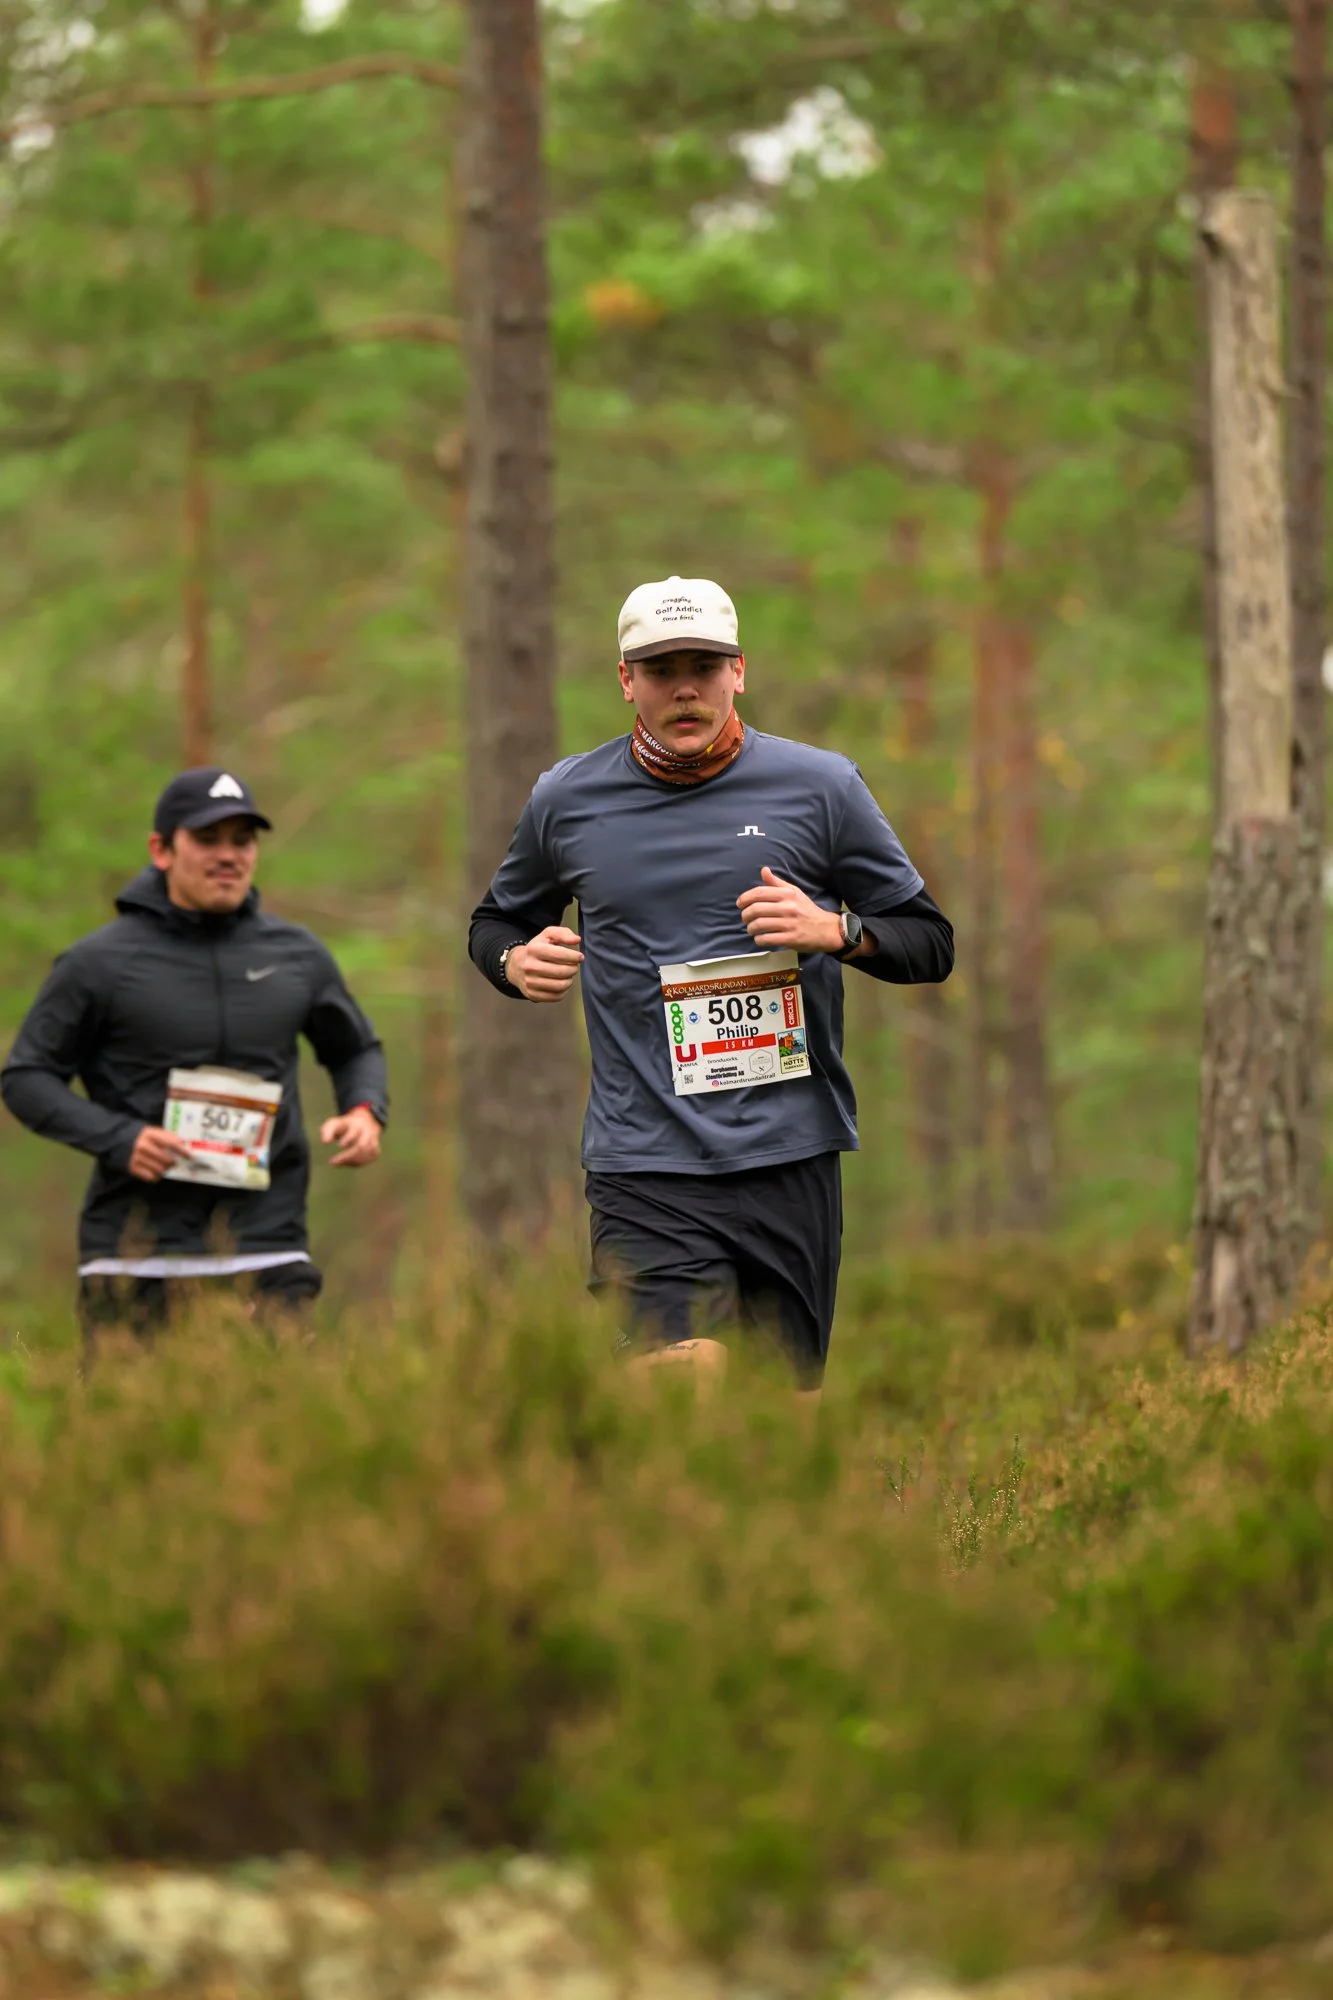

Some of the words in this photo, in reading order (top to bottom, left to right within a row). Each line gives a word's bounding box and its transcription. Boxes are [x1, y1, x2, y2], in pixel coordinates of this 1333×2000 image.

[655, 606, 673, 615] Golf
[708, 994, 763, 1025] 508
[786, 1001, 795, 1025] CIRCLE
[670, 1003, 684, 1044] coop
[716, 1024, 759, 1039] Philip
[201, 1105, 244, 1131] 507
